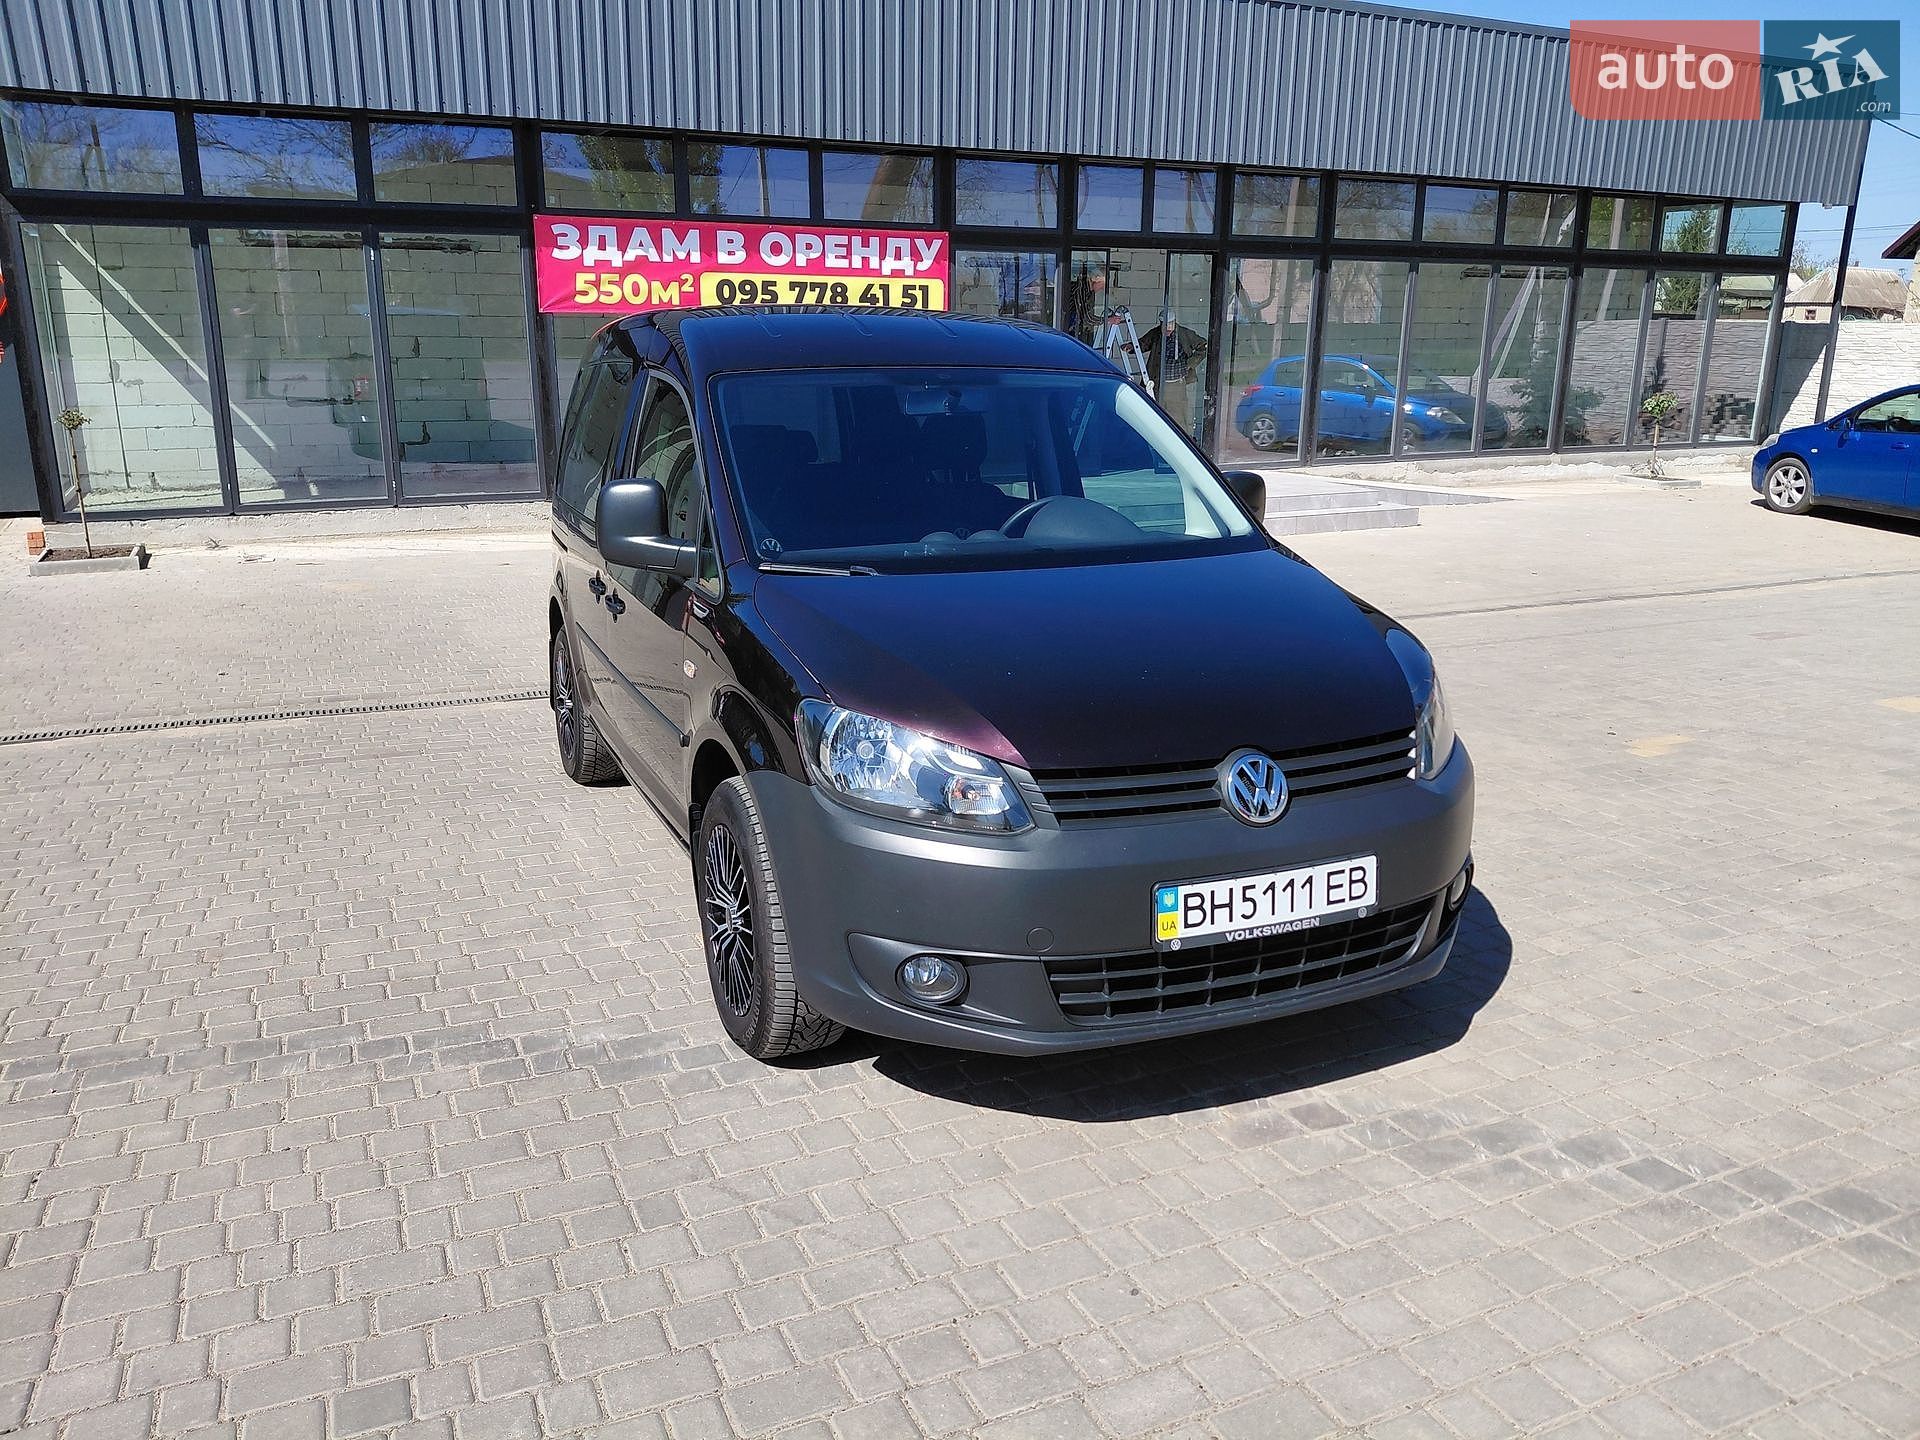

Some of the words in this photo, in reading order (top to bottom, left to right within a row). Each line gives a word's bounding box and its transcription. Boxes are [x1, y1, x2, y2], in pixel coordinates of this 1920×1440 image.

[550, 223, 701, 268] ЗДАМ
[716, 230, 748, 265] В
[759, 231, 944, 277] ОРЕНДУ
[715, 278, 779, 305] 095
[788, 280, 849, 306] 778
[858, 283, 891, 307] 41
[900, 284, 930, 309] 51
[1161, 920, 1177, 932] UA
[1225, 916, 1321, 943] VOLKSWAGEN
